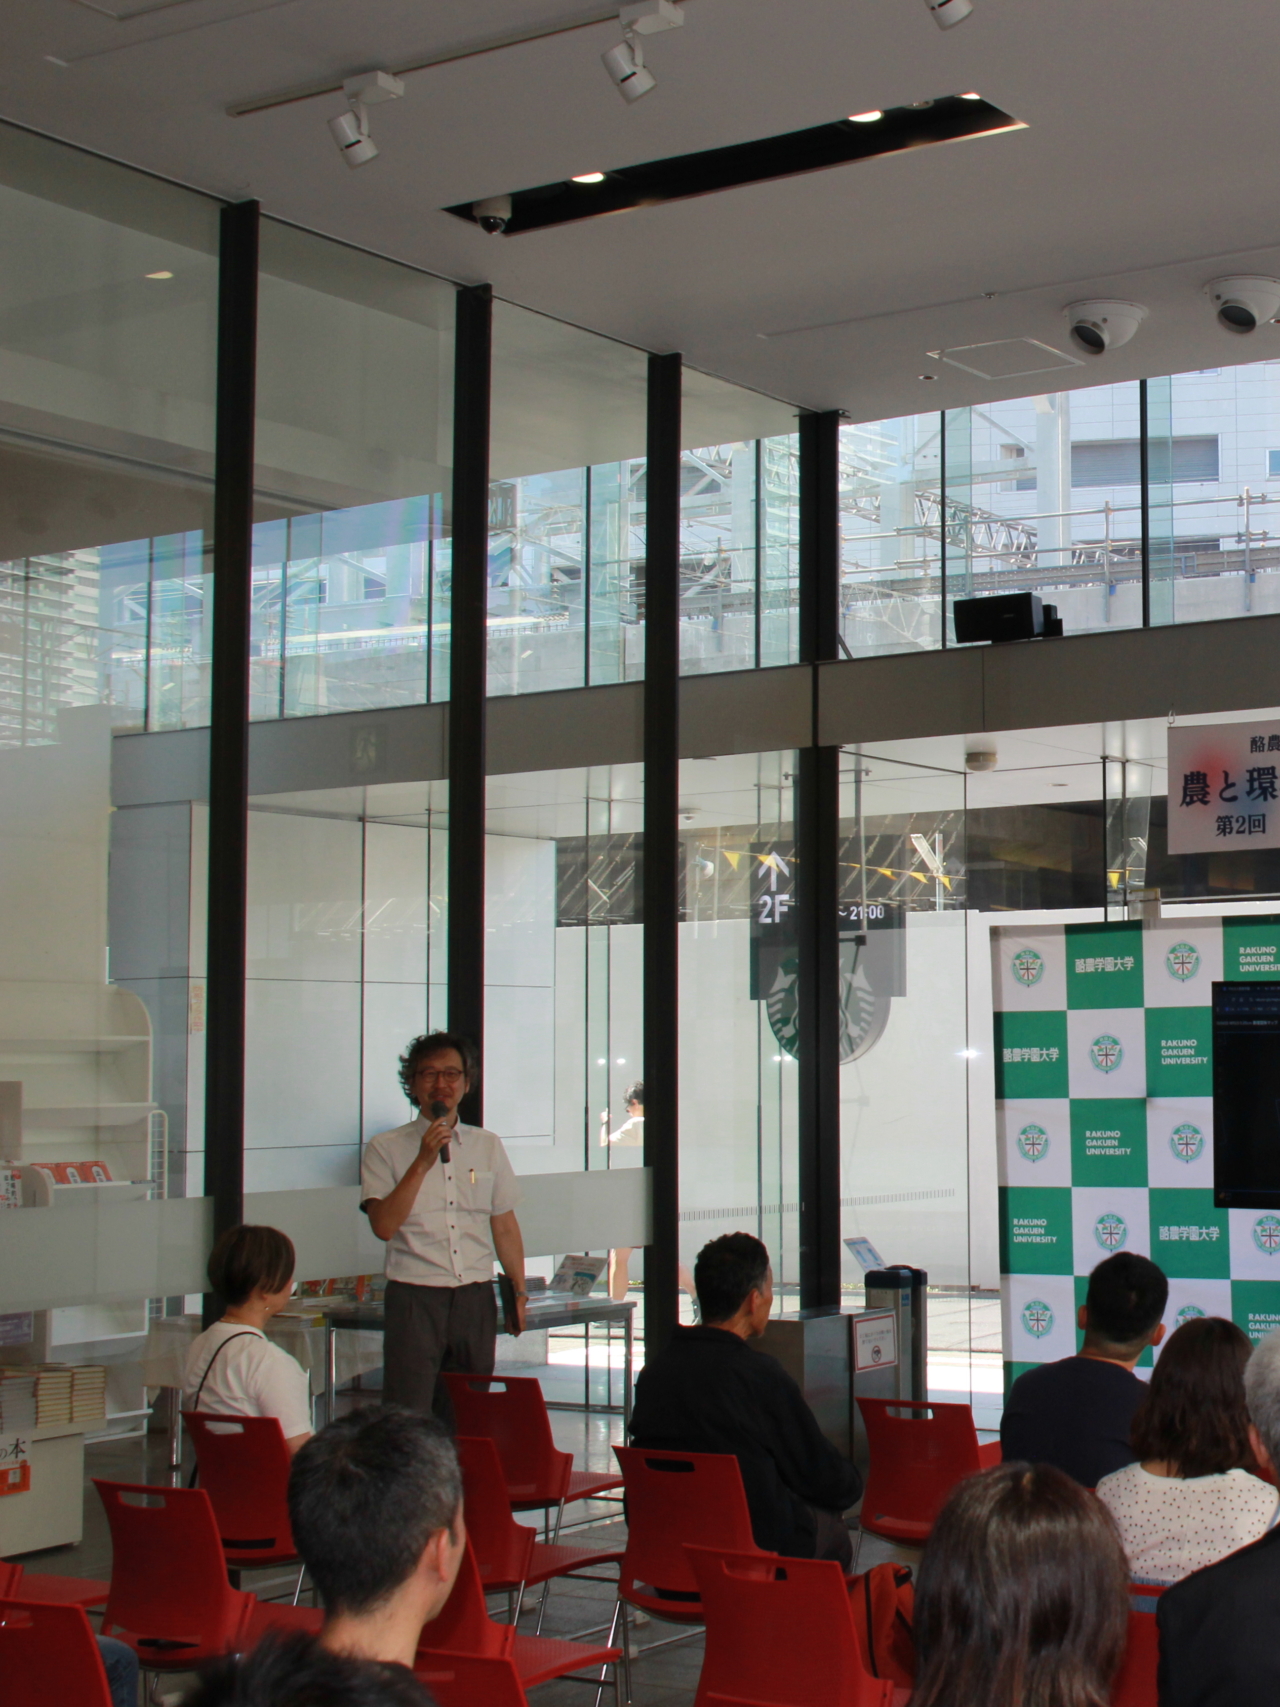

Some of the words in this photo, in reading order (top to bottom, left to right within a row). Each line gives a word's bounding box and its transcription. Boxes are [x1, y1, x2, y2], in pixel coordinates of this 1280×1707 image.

[1215, 813, 1267, 837] 第2回
[758, 894, 789, 924] 2F
[1240, 946, 1276, 954] RAKUNO
[1075, 956, 1134, 973] 酪農学園大学
[1240, 955, 1274, 963] GAKUEN
[1003, 1047, 1059, 1063] 酪農学園大学
[1161, 1048, 1194, 1056] GAKUEN
[1162, 1057, 1208, 1065] UNIVERSITY
[1159, 1226, 1220, 1241] 酪農学園大学
